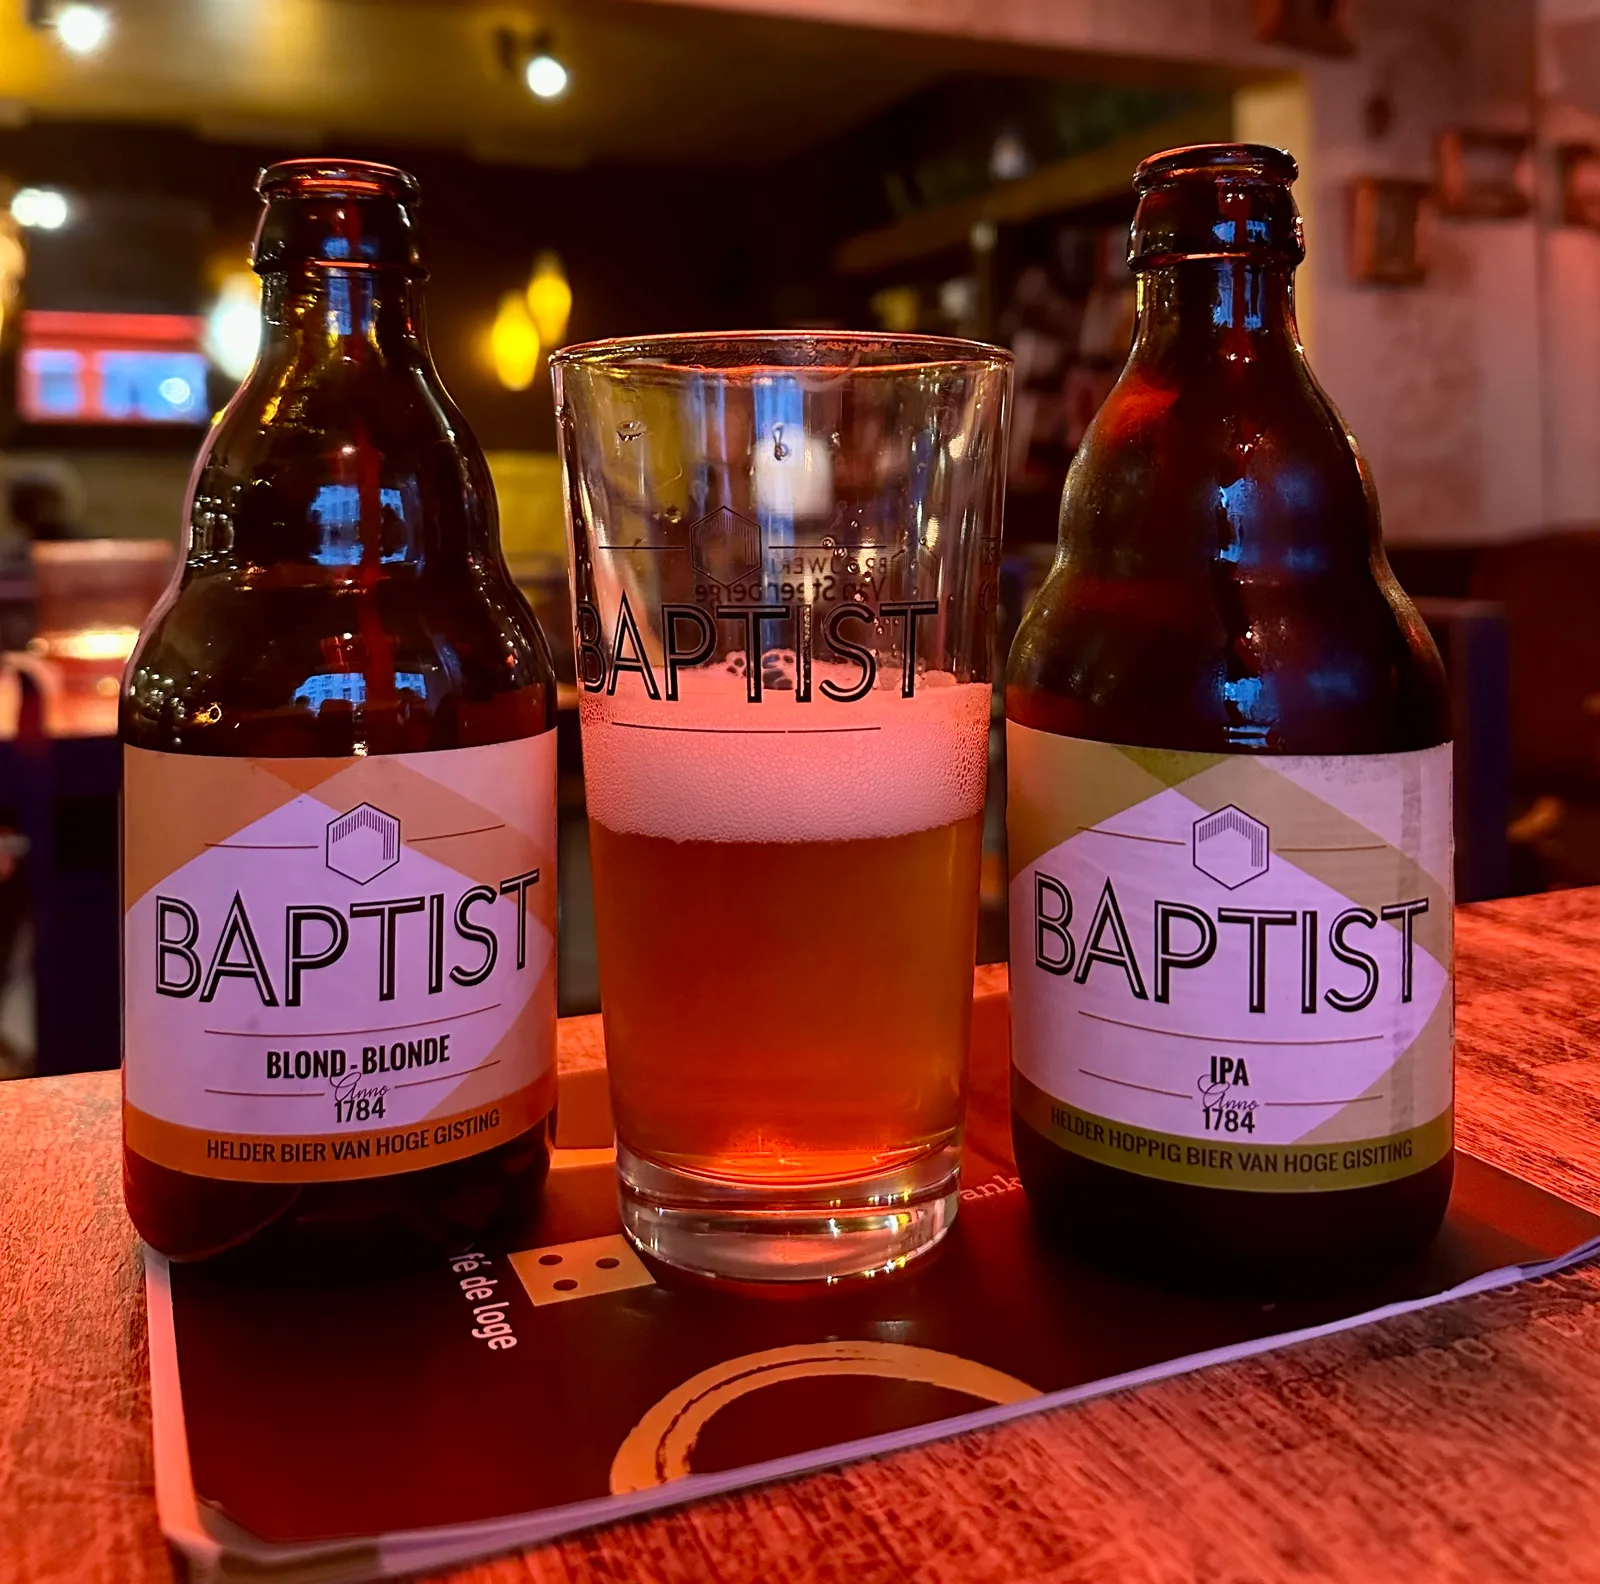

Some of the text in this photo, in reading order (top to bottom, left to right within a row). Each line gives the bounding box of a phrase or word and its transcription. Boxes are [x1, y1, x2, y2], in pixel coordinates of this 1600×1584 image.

[577, 590, 939, 704] BAPTIST
[155, 867, 541, 1007] BAPTIST
[1034, 870, 1430, 1014] BAPTIST
[329, 1071, 391, 1102] Anno
[1197, 1073, 1260, 1112] Anno
[1210, 1055, 1250, 1087] IPA
[334, 1096, 387, 1123] 1784
[1202, 1106, 1256, 1134] 1784
[206, 1108, 500, 1163] HELDER BIER VAN HOGE GISTING
[1051, 1105, 1413, 1174] HELDER HOPPIG BIER VAN HOGE GISITING
[459, 1276, 499, 1301] de
[471, 1301, 519, 1351] loge
